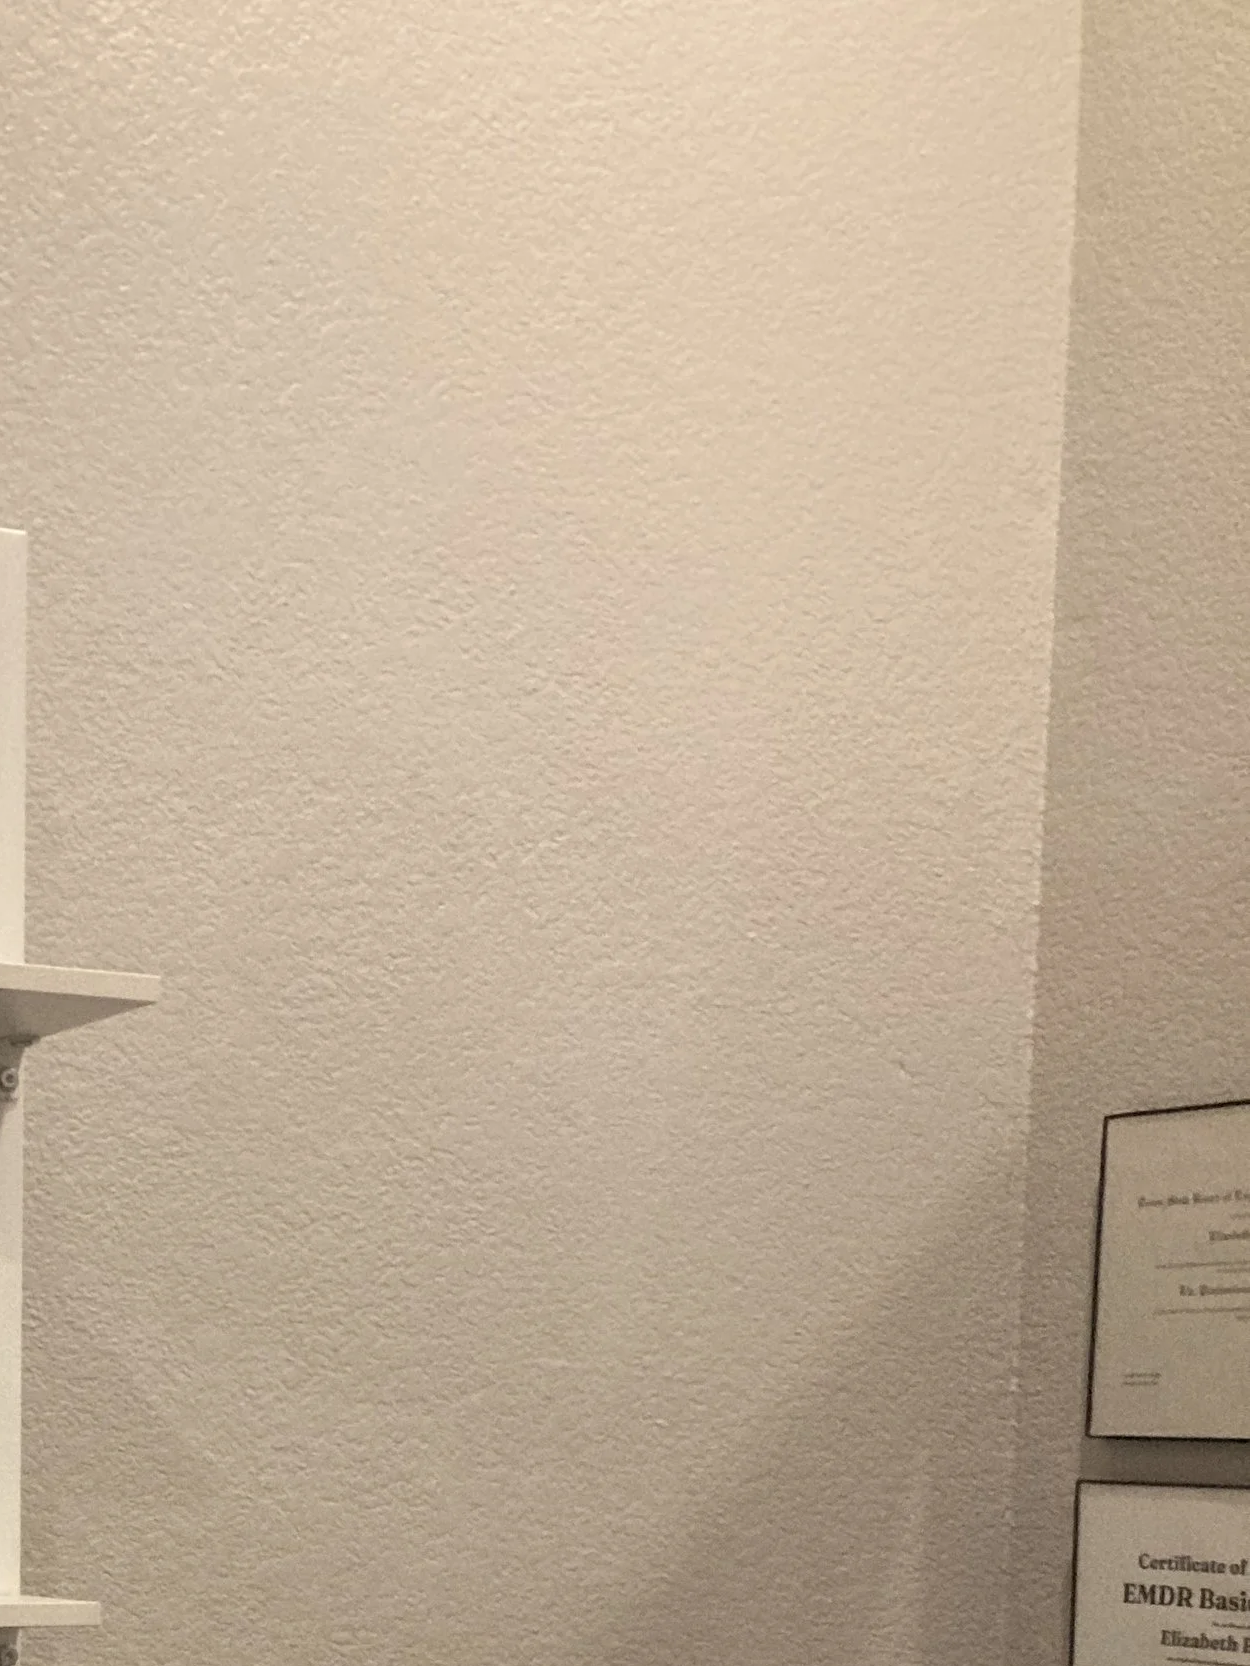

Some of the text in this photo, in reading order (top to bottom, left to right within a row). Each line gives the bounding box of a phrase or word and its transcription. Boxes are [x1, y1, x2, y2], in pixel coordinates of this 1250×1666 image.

[1137, 1553, 1249, 1576] Certificate of
[1122, 1582, 1250, 1612] EMDR Basi
[1160, 1628, 1240, 1653] Elizabeth
